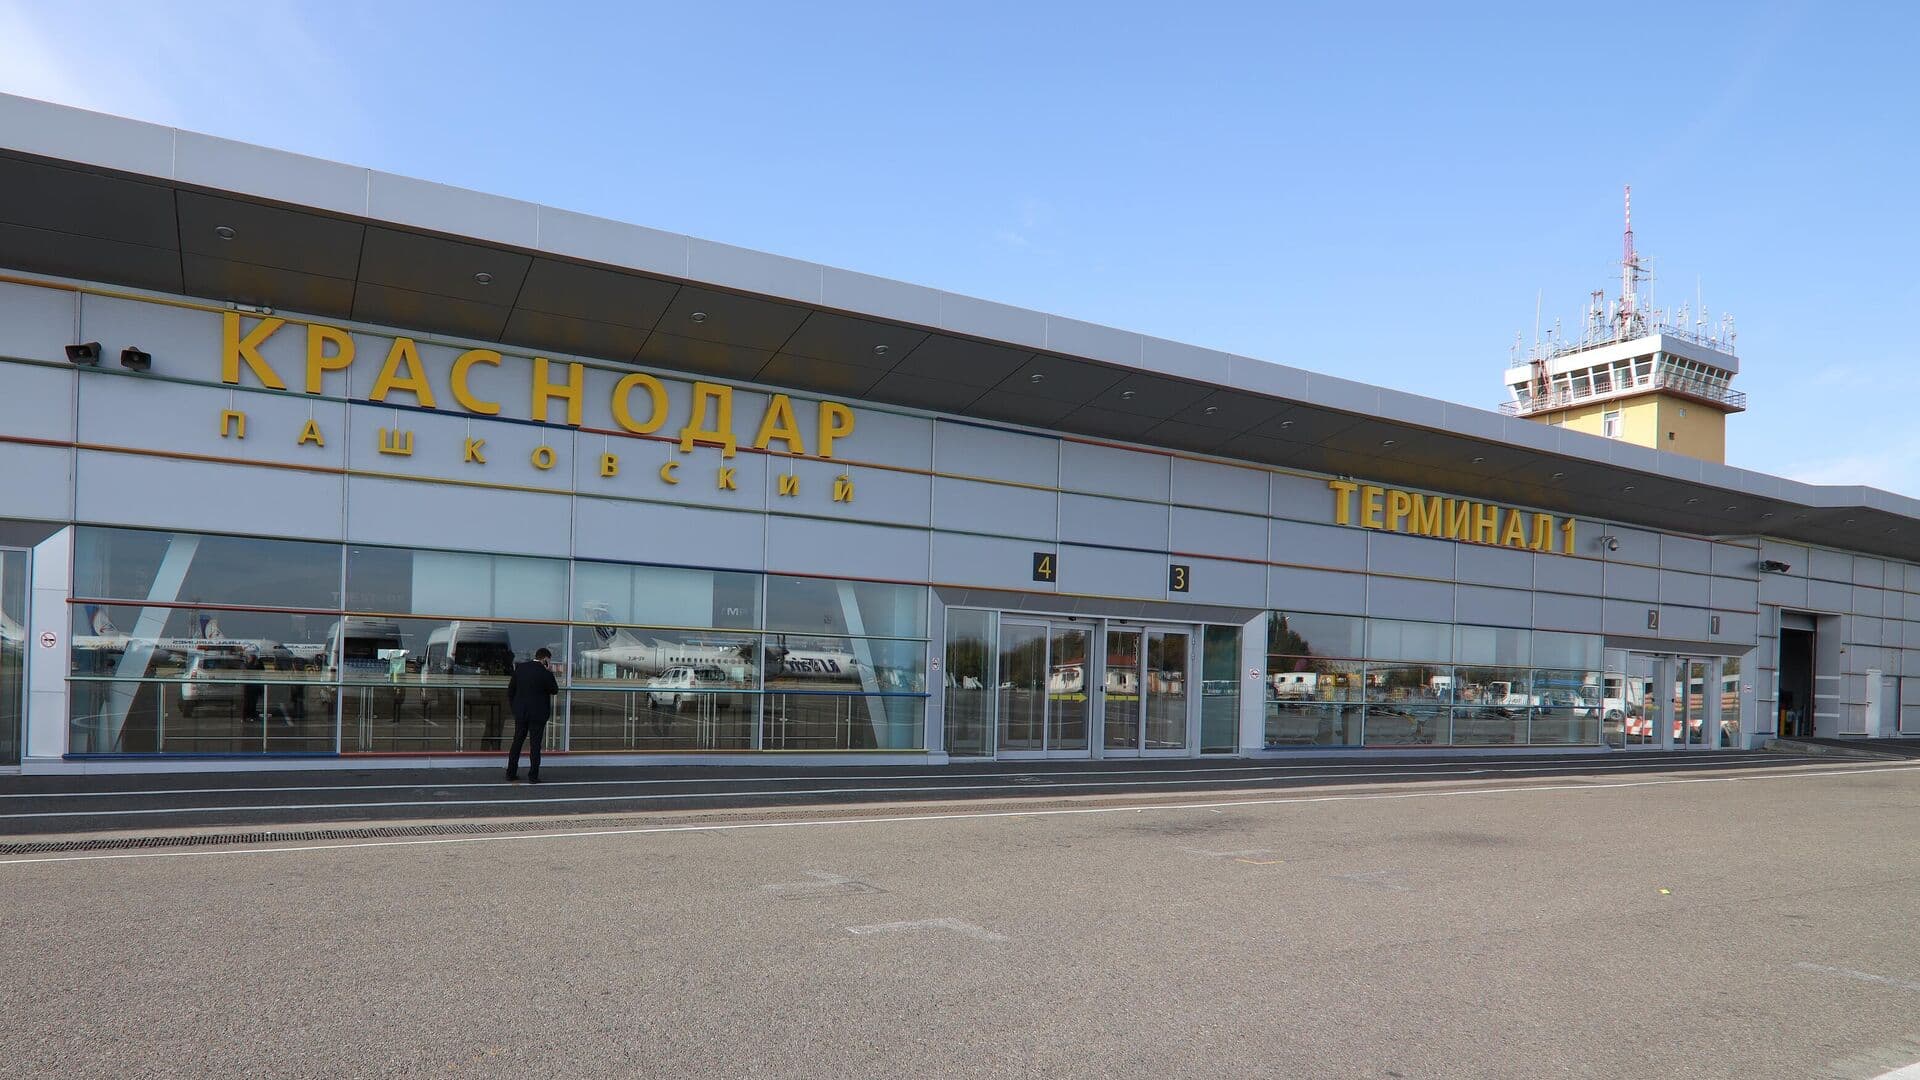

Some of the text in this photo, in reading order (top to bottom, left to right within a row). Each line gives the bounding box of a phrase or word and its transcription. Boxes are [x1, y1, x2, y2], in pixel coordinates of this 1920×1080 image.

[222, 311, 855, 458] КРАСНОДАР
[220, 409, 855, 502] ПАШКОВСКИЙ
[1328, 480, 1576, 555] ТЕРМИНАЛ 1
[1038, 556, 1051, 579] 4
[1174, 567, 1185, 590] 3
[1650, 612, 1657, 628] 2
